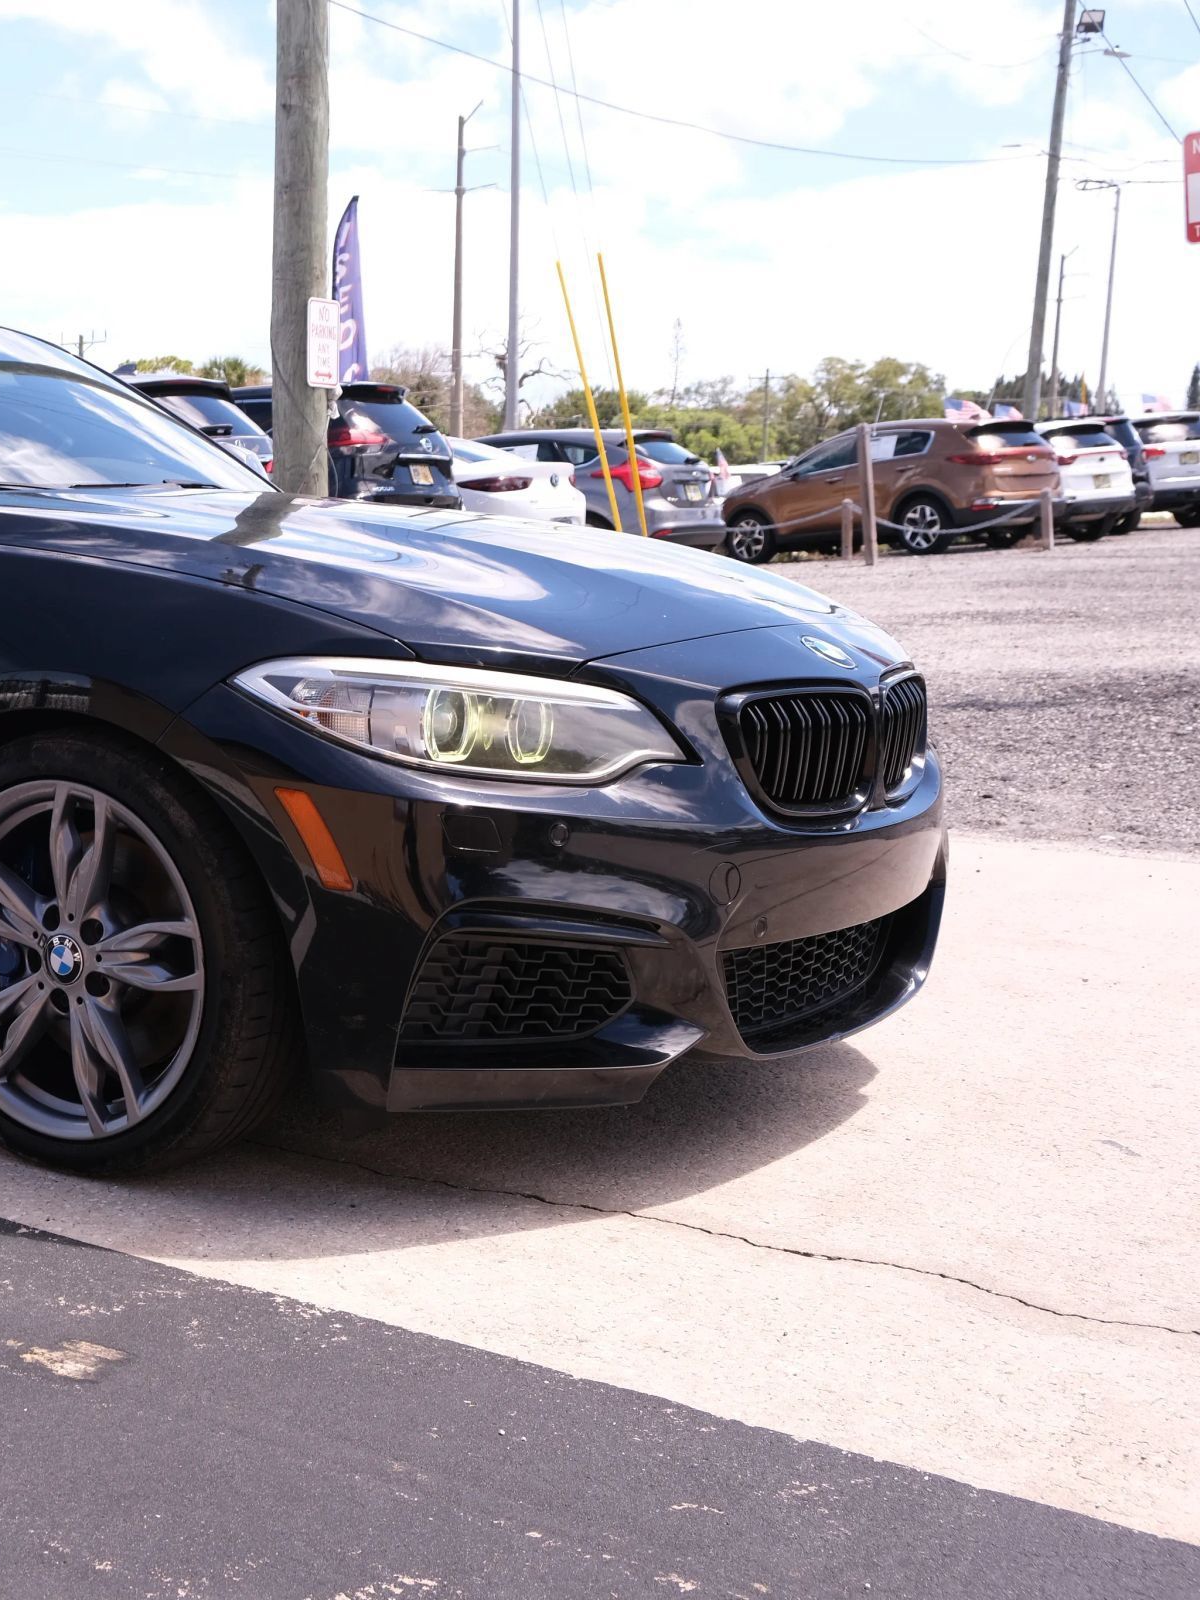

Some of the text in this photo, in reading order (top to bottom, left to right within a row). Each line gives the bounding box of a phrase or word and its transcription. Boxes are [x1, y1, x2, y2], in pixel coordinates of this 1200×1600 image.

[319, 307, 330, 321] NO
[311, 323, 337, 340] PARKING
[52, 937, 81, 962] BMW
